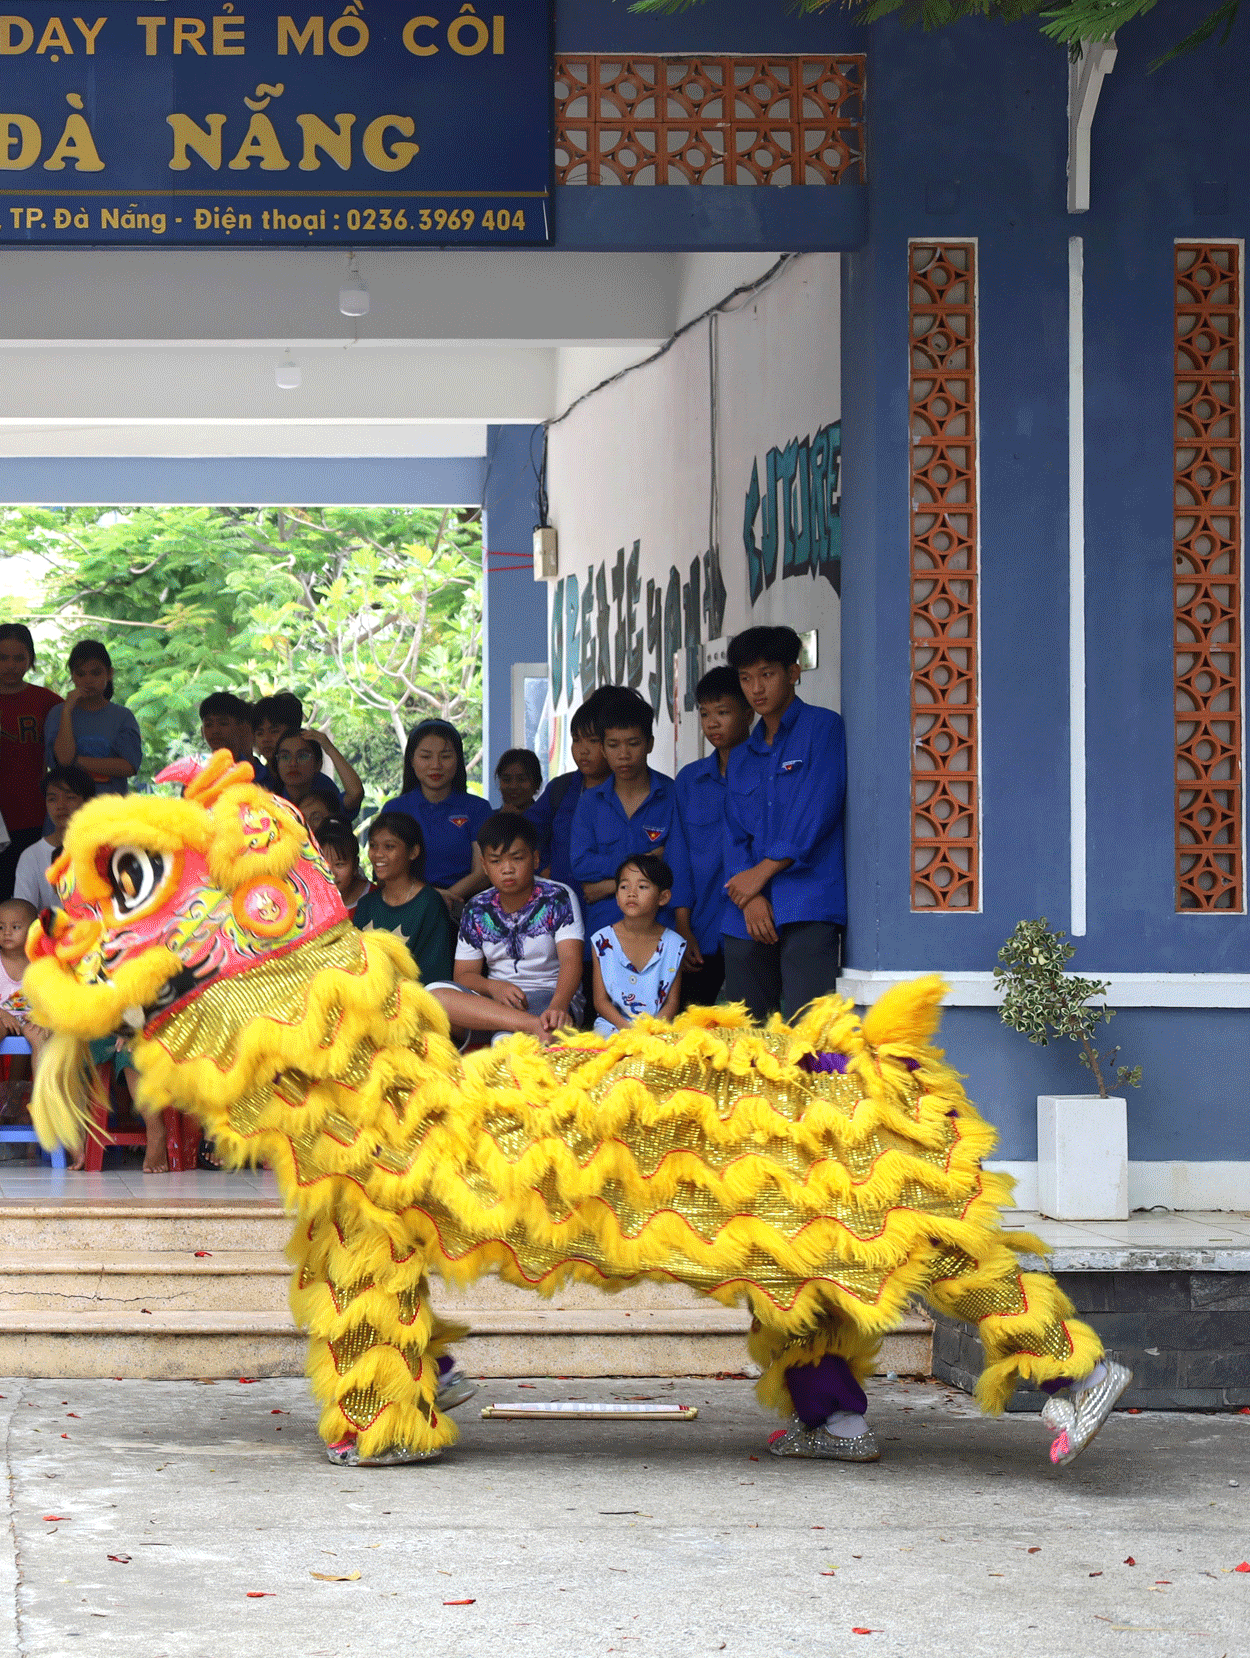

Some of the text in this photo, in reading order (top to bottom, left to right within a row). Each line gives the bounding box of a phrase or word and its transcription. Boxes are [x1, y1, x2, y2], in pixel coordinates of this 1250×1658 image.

[137, 3, 246, 56] TRẺ
[277, 0, 370, 57] MỒ
[402, 4, 505, 57] CÔI
[166, 83, 420, 172] NẴNG
[9, 207, 47, 230] TP.
[52, 207, 90, 230] Đà
[100, 203, 167, 235] Nẵng
[193, 206, 253, 236] Điện
